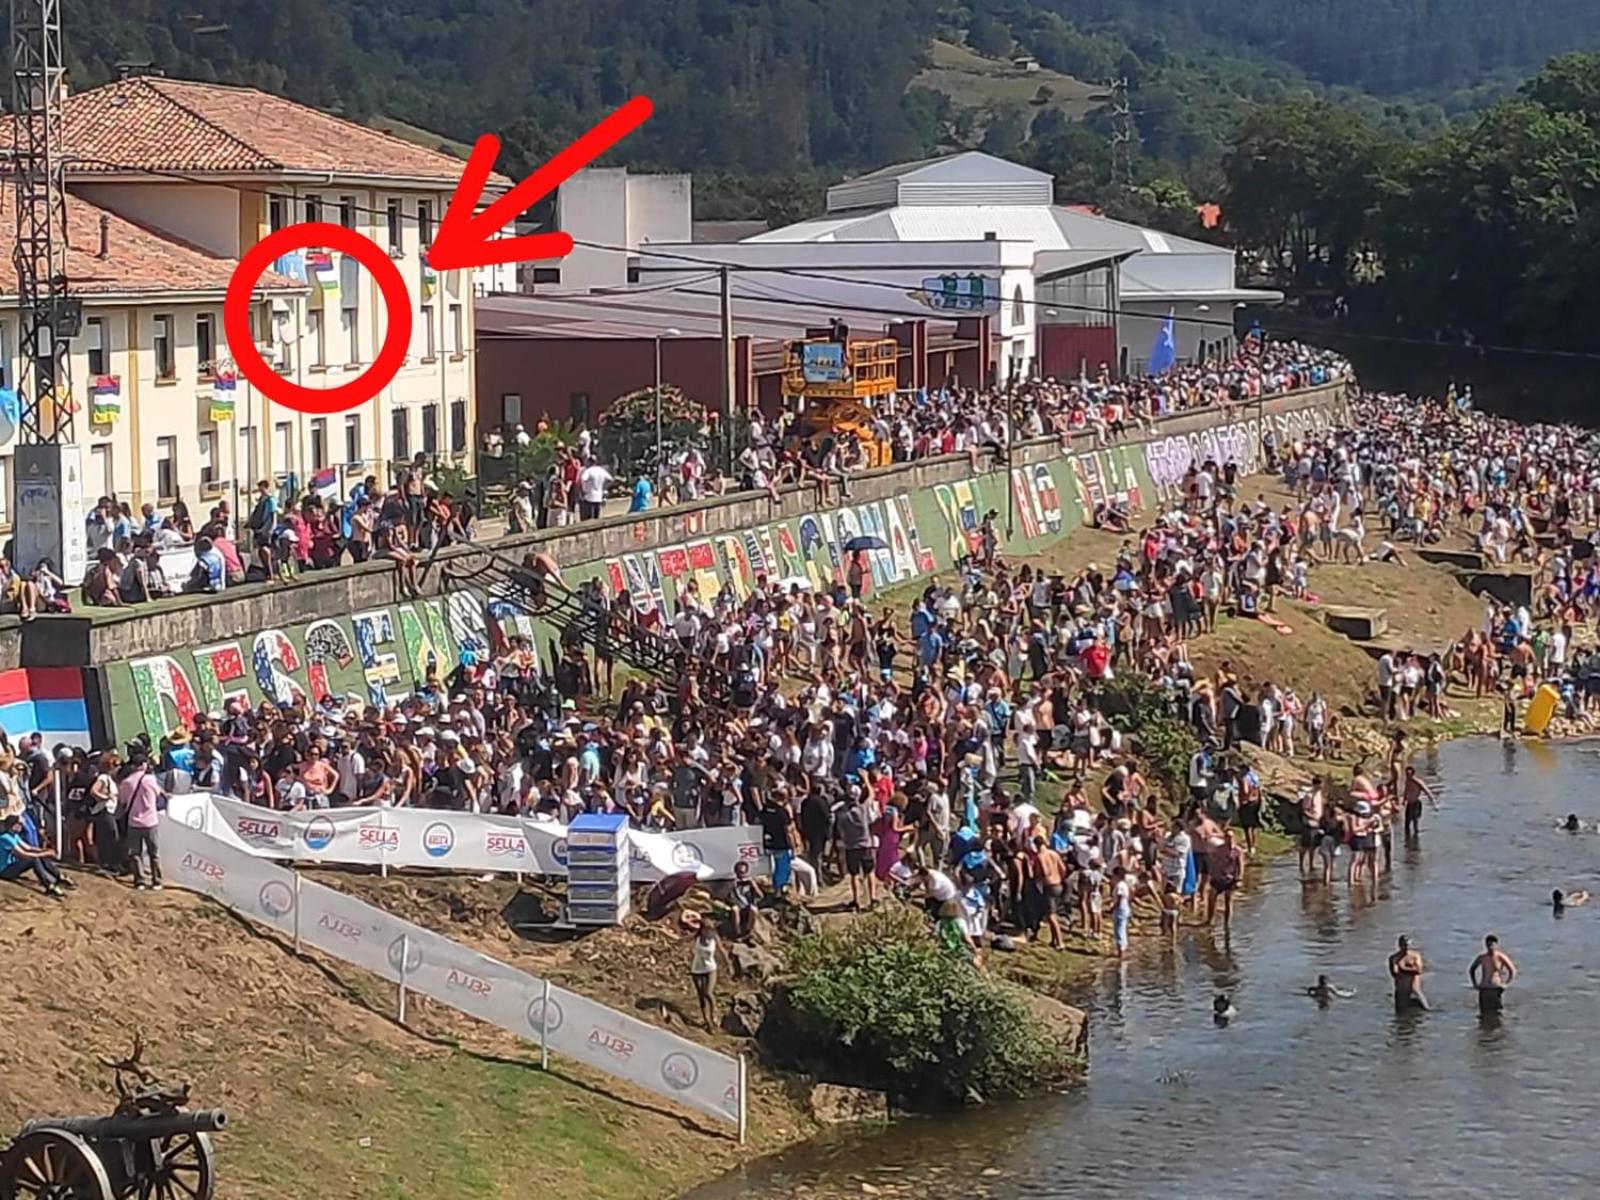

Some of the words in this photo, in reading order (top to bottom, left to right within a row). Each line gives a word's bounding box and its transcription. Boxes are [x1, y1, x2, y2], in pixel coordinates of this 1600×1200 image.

[238, 820, 279, 838] SELLA
[359, 828, 399, 844] SELLA
[487, 836, 526, 850] SELLA
